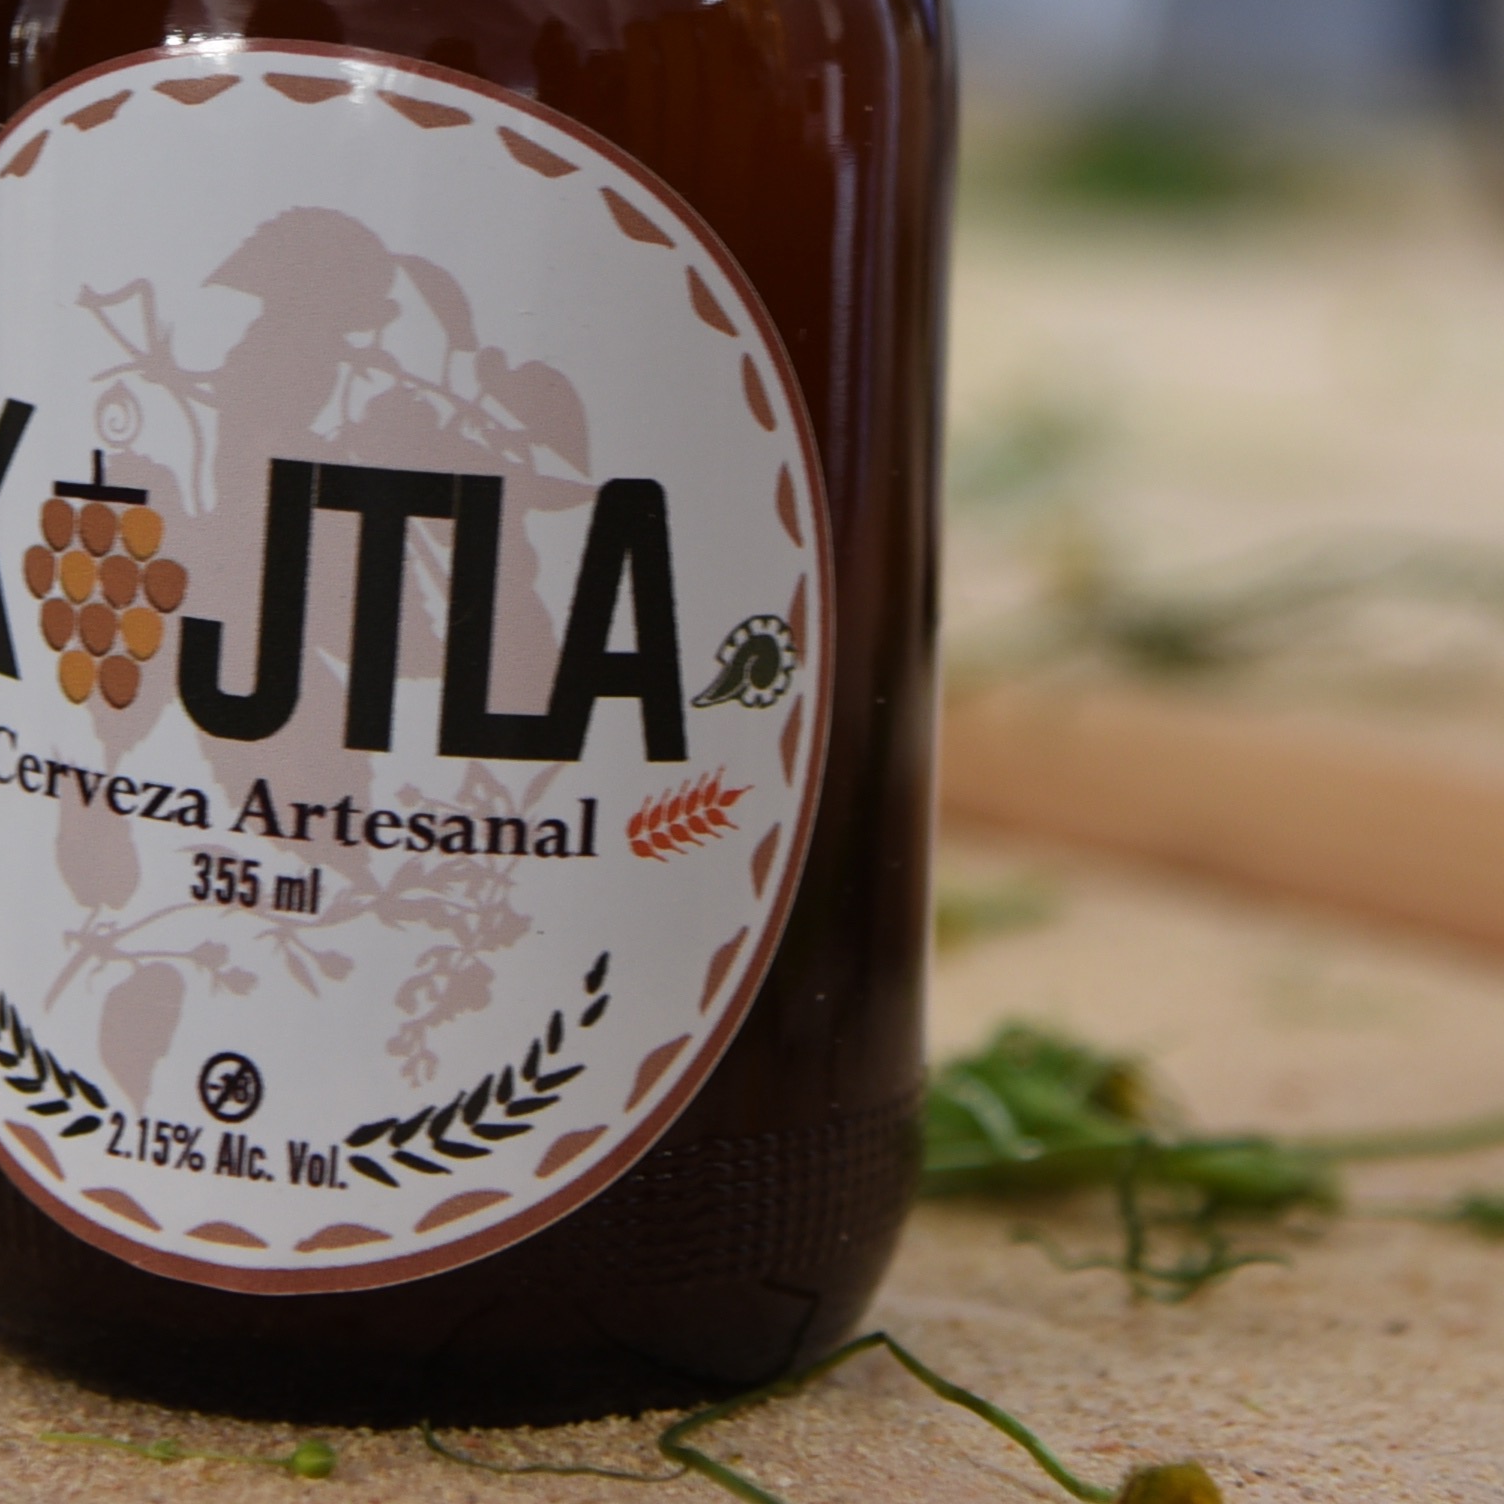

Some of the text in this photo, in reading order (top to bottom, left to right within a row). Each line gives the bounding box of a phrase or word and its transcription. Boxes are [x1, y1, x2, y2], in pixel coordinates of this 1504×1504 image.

[228, 778, 599, 857] Artesanal
[190, 852, 320, 914] 355 ml
[106, 1111, 347, 1189] 2.15% Alc. Vol.
